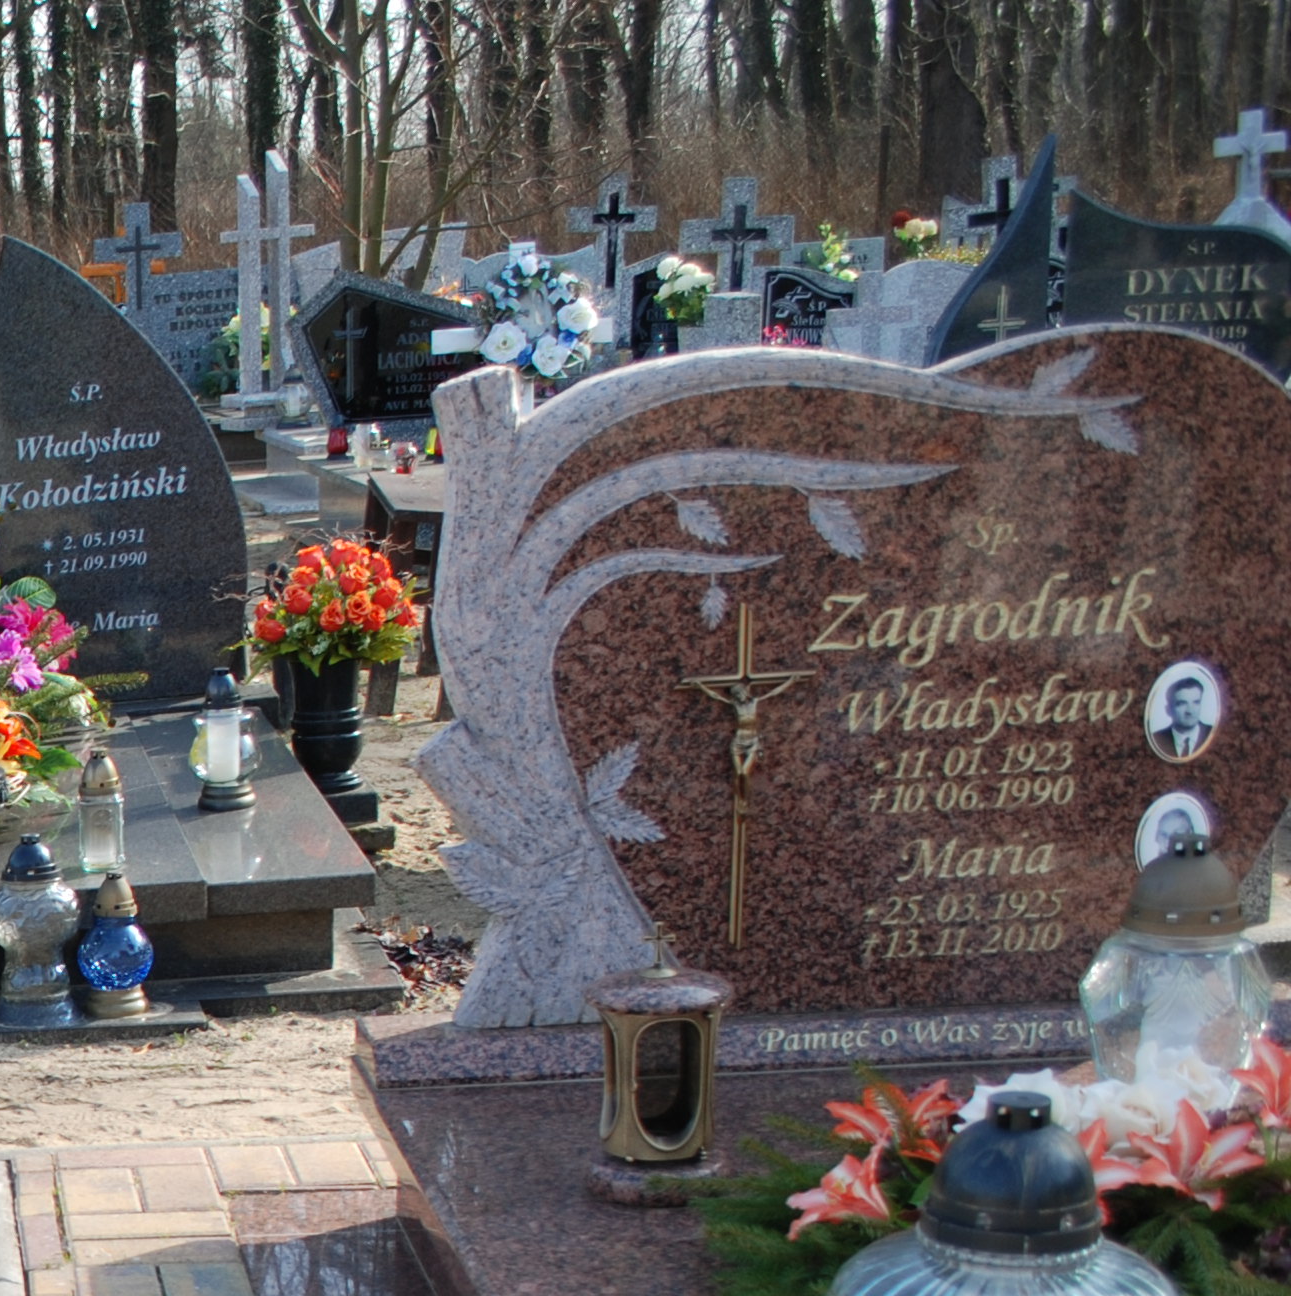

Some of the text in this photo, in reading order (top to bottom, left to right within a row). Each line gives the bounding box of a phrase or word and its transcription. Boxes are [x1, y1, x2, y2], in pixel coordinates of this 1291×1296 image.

[1125, 263, 1268, 297] DYNEK
[1123, 299, 1264, 325] STEFANIA
[377, 350, 460, 370] LACHOWICZ
[69, 379, 104, 402] Ś.P.
[15, 426, 162, 464] Władysław
[58, 550, 148, 575] 21.09.1990
[91, 608, 160, 633] Maria
[807, 567, 1171, 669] Zagrodnik
[837, 672, 1136, 744] Władysław
[896, 831, 1057, 883] Maria
[757, 1022, 870, 1056] Pamięć
[880, 1027, 899, 1047] o
[907, 1015, 981, 1044] Was
[990, 1012, 1054, 1049] żyje
